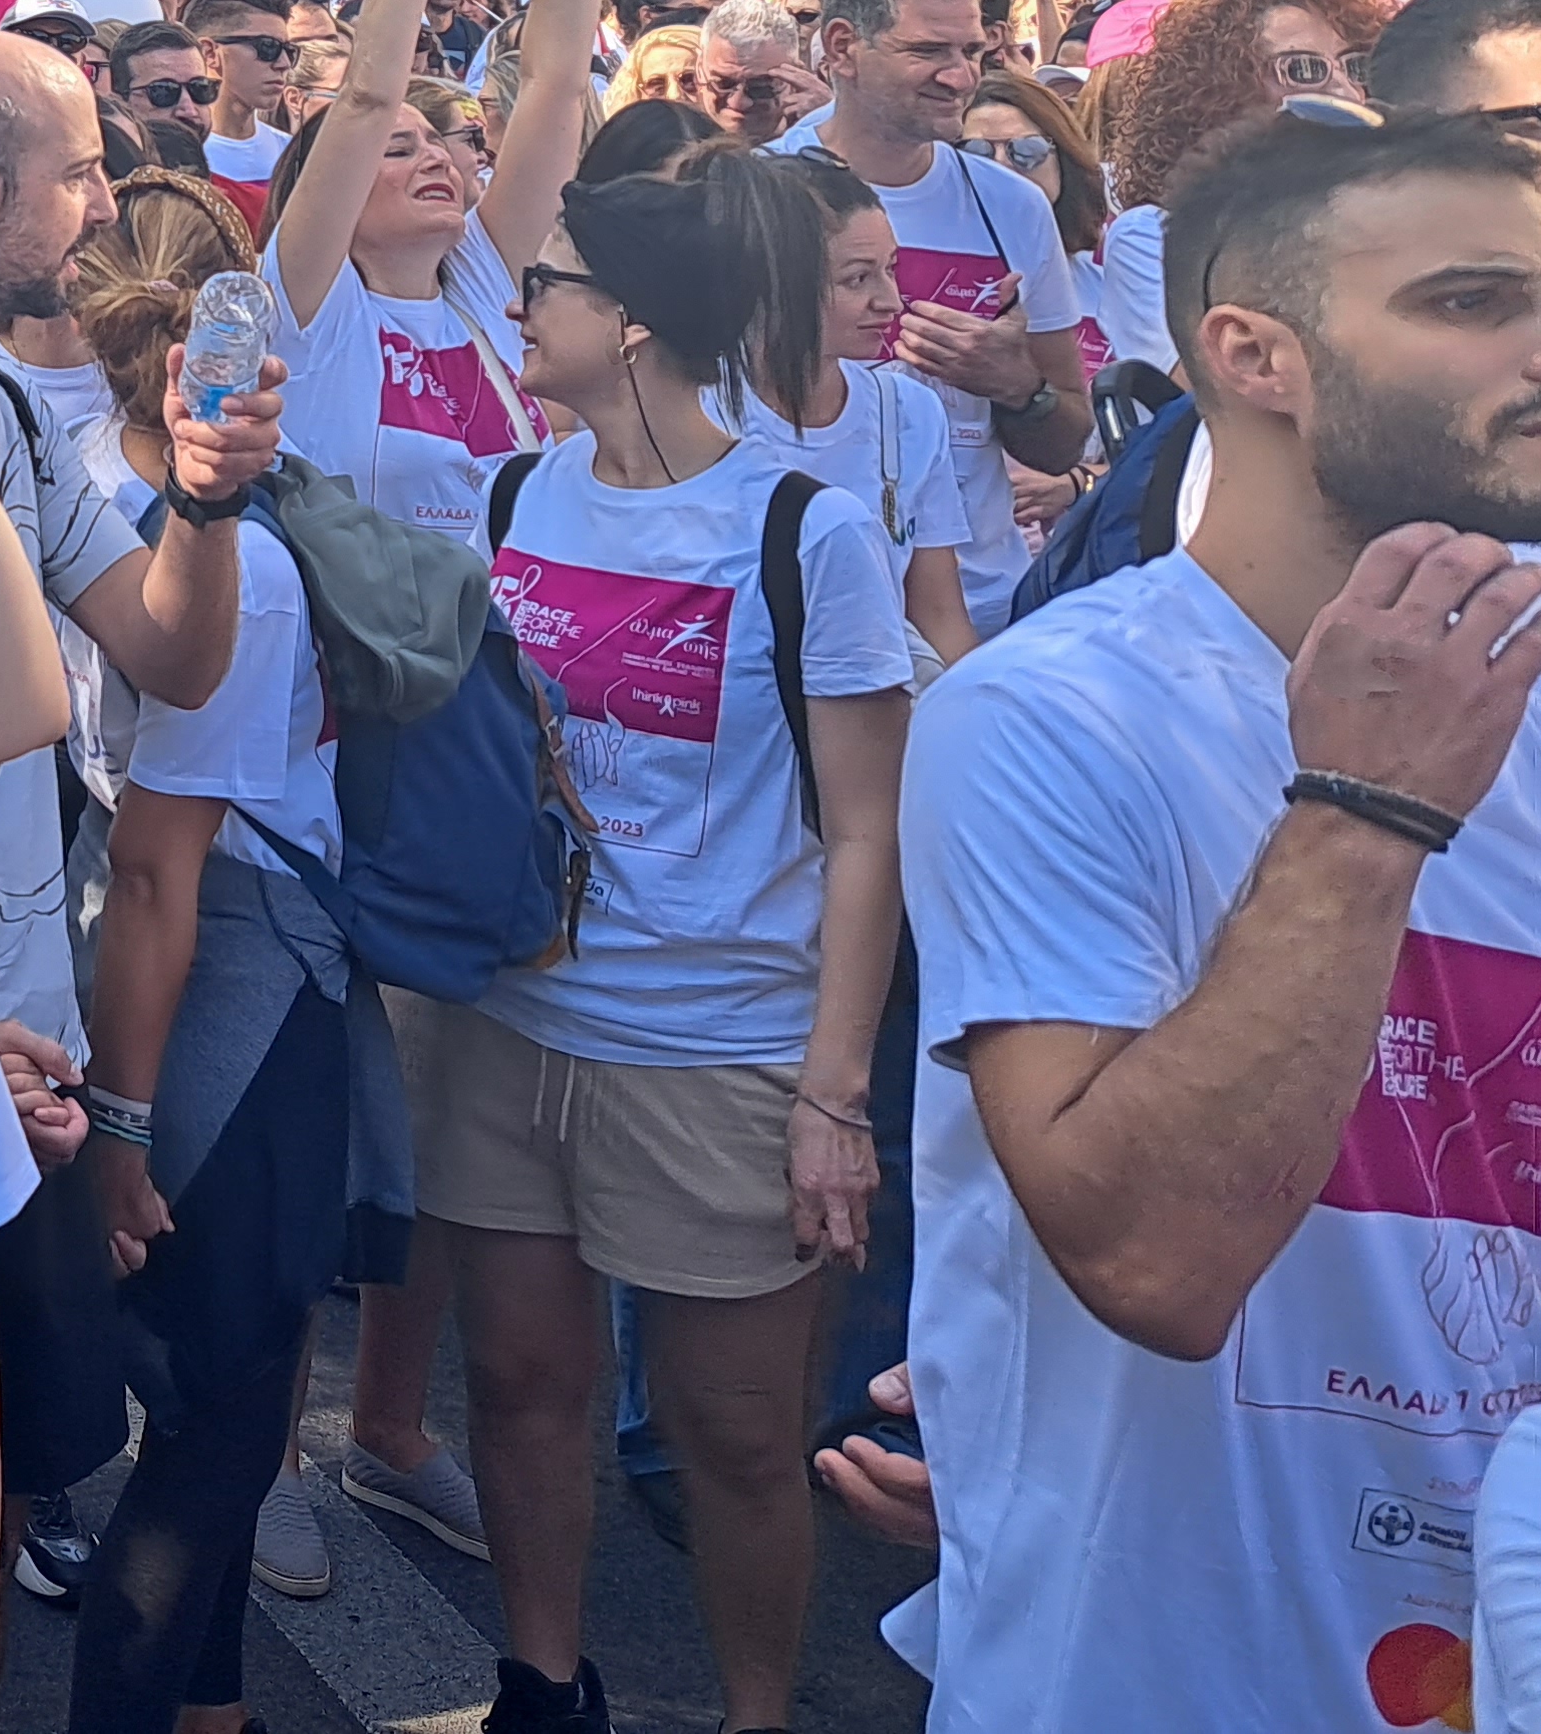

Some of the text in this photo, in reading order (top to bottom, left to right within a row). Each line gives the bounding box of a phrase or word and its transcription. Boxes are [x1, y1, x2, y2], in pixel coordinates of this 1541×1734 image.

[416, 505, 472, 521] ΕΛΛΑΔΑ
[526, 602, 576, 624] RACE
[524, 617, 552, 632] FOR
[555, 621, 584, 640] THE
[600, 815, 644, 837] 2023
[1380, 1014, 1439, 1047] RACE
